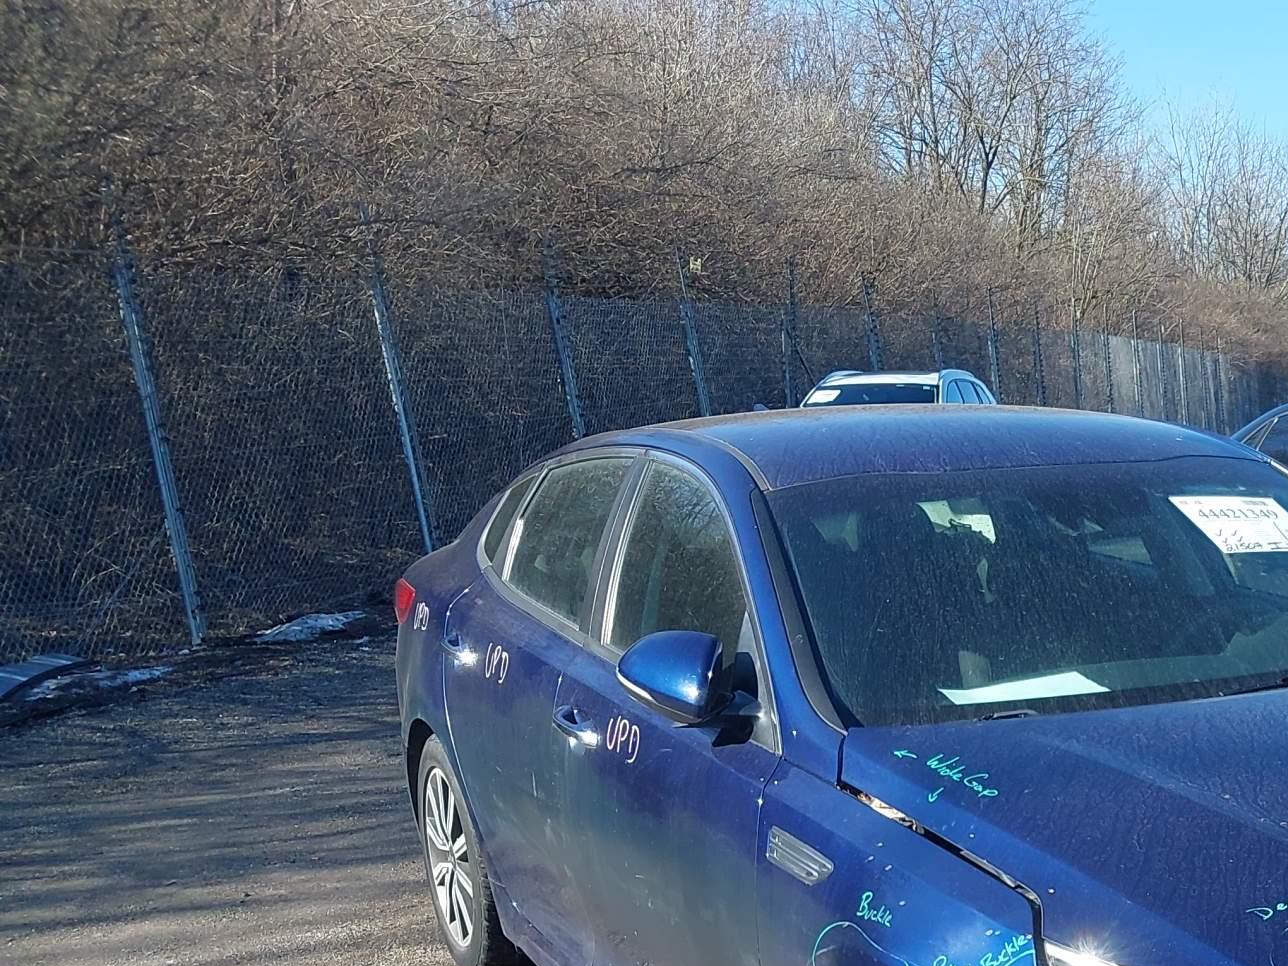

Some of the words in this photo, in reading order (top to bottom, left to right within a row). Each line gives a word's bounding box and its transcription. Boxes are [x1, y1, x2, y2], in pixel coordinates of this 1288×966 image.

[1198, 508, 1278, 520] 44421349
[413, 601, 431, 631] UPD
[485, 642, 509, 683] UPD
[606, 715, 641, 763] UPD
[926, 753, 964, 783] Wide
[963, 773, 999, 798] Gap
[856, 891, 892, 928] Buckle
